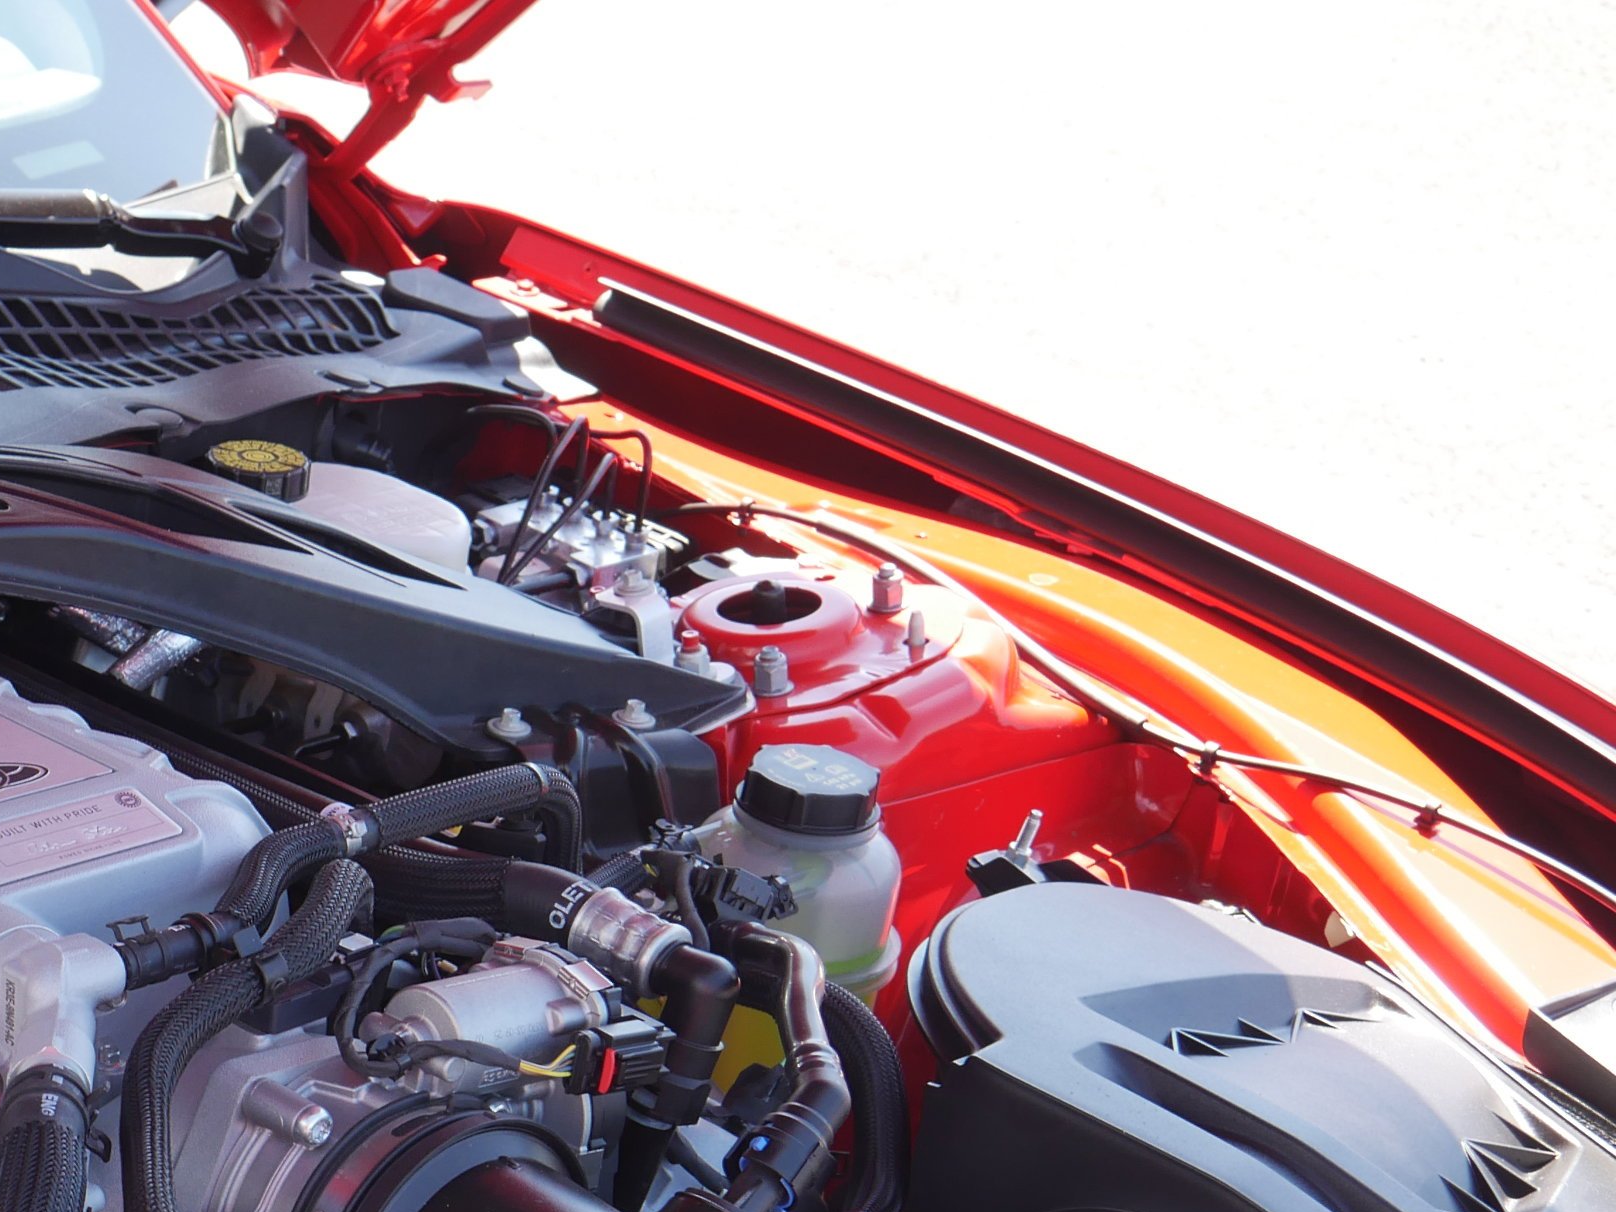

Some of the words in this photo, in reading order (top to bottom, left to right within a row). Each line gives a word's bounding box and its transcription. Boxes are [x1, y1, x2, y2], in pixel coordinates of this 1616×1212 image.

[30, 815, 64, 829] WITH
[64, 804, 103, 820] PRIDE
[41, 1093, 59, 1117] ENG
